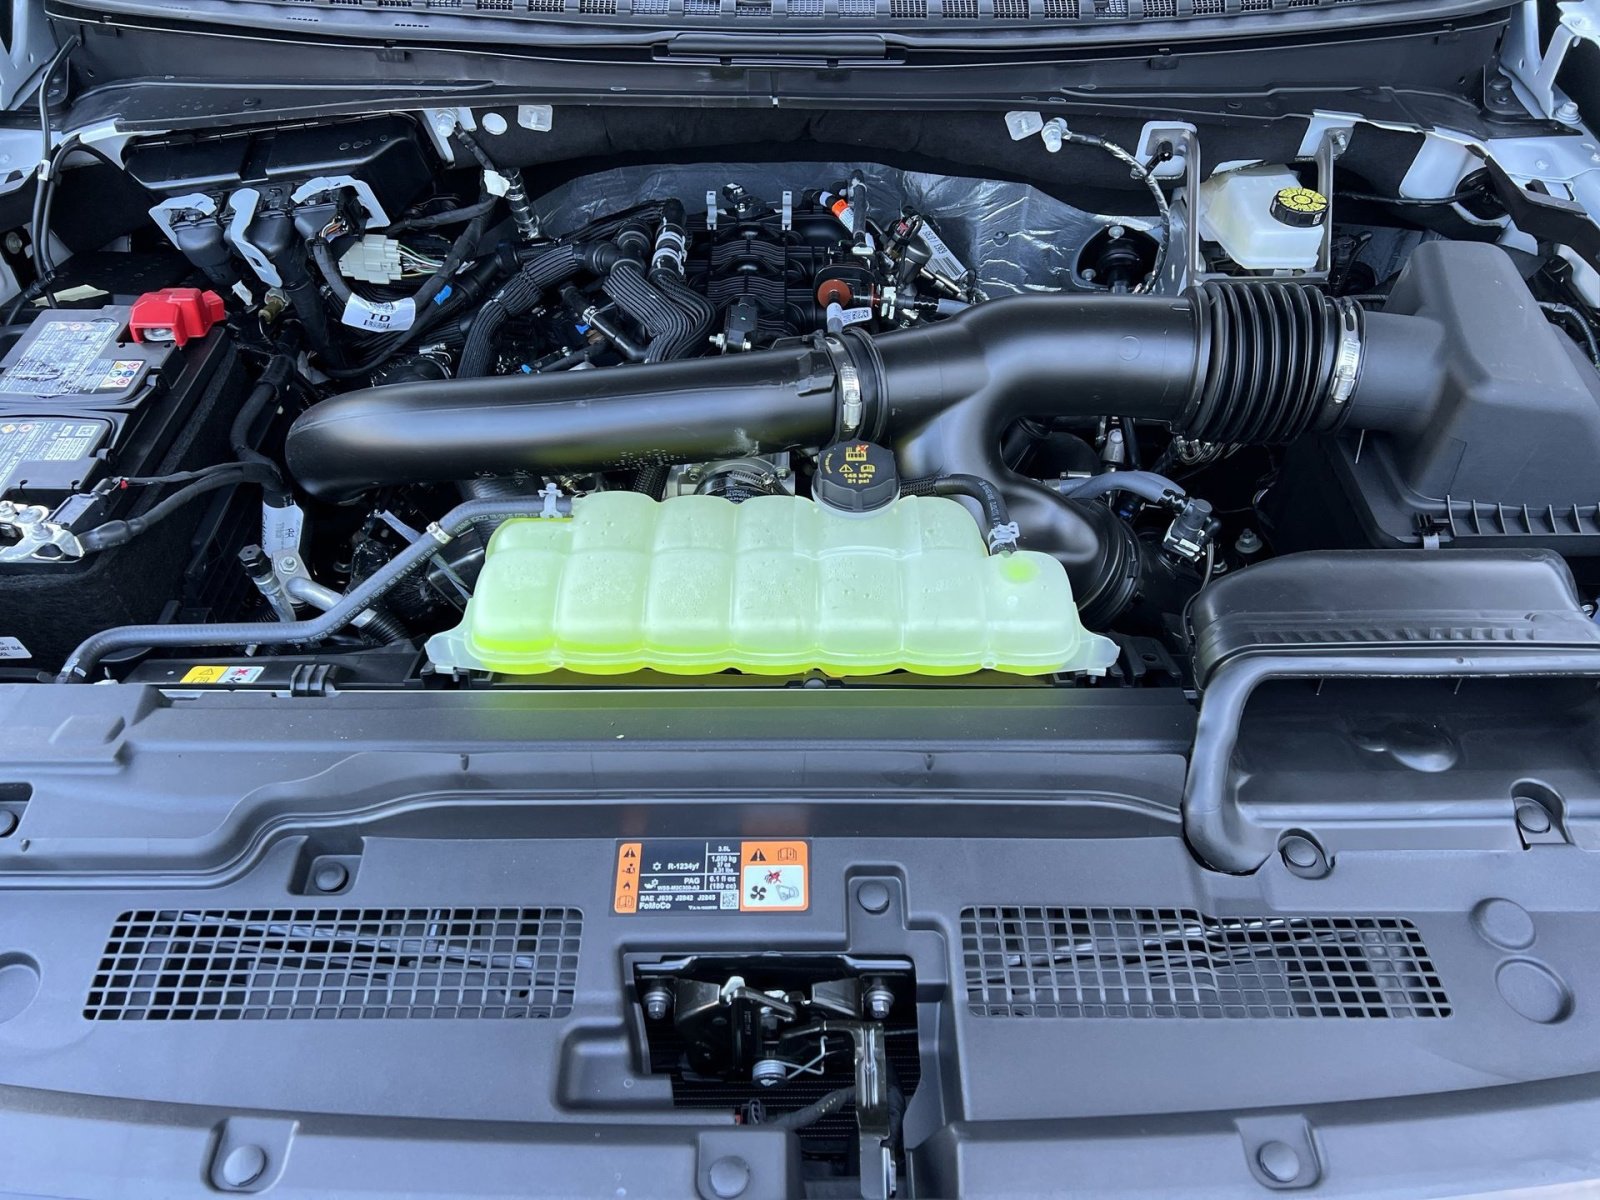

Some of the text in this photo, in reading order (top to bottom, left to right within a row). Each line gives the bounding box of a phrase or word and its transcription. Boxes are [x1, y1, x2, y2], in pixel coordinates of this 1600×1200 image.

[728, 855, 737, 864] kg
[667, 862, 700, 871] R-1234yf
[639, 901, 671, 910] FoMoCo
